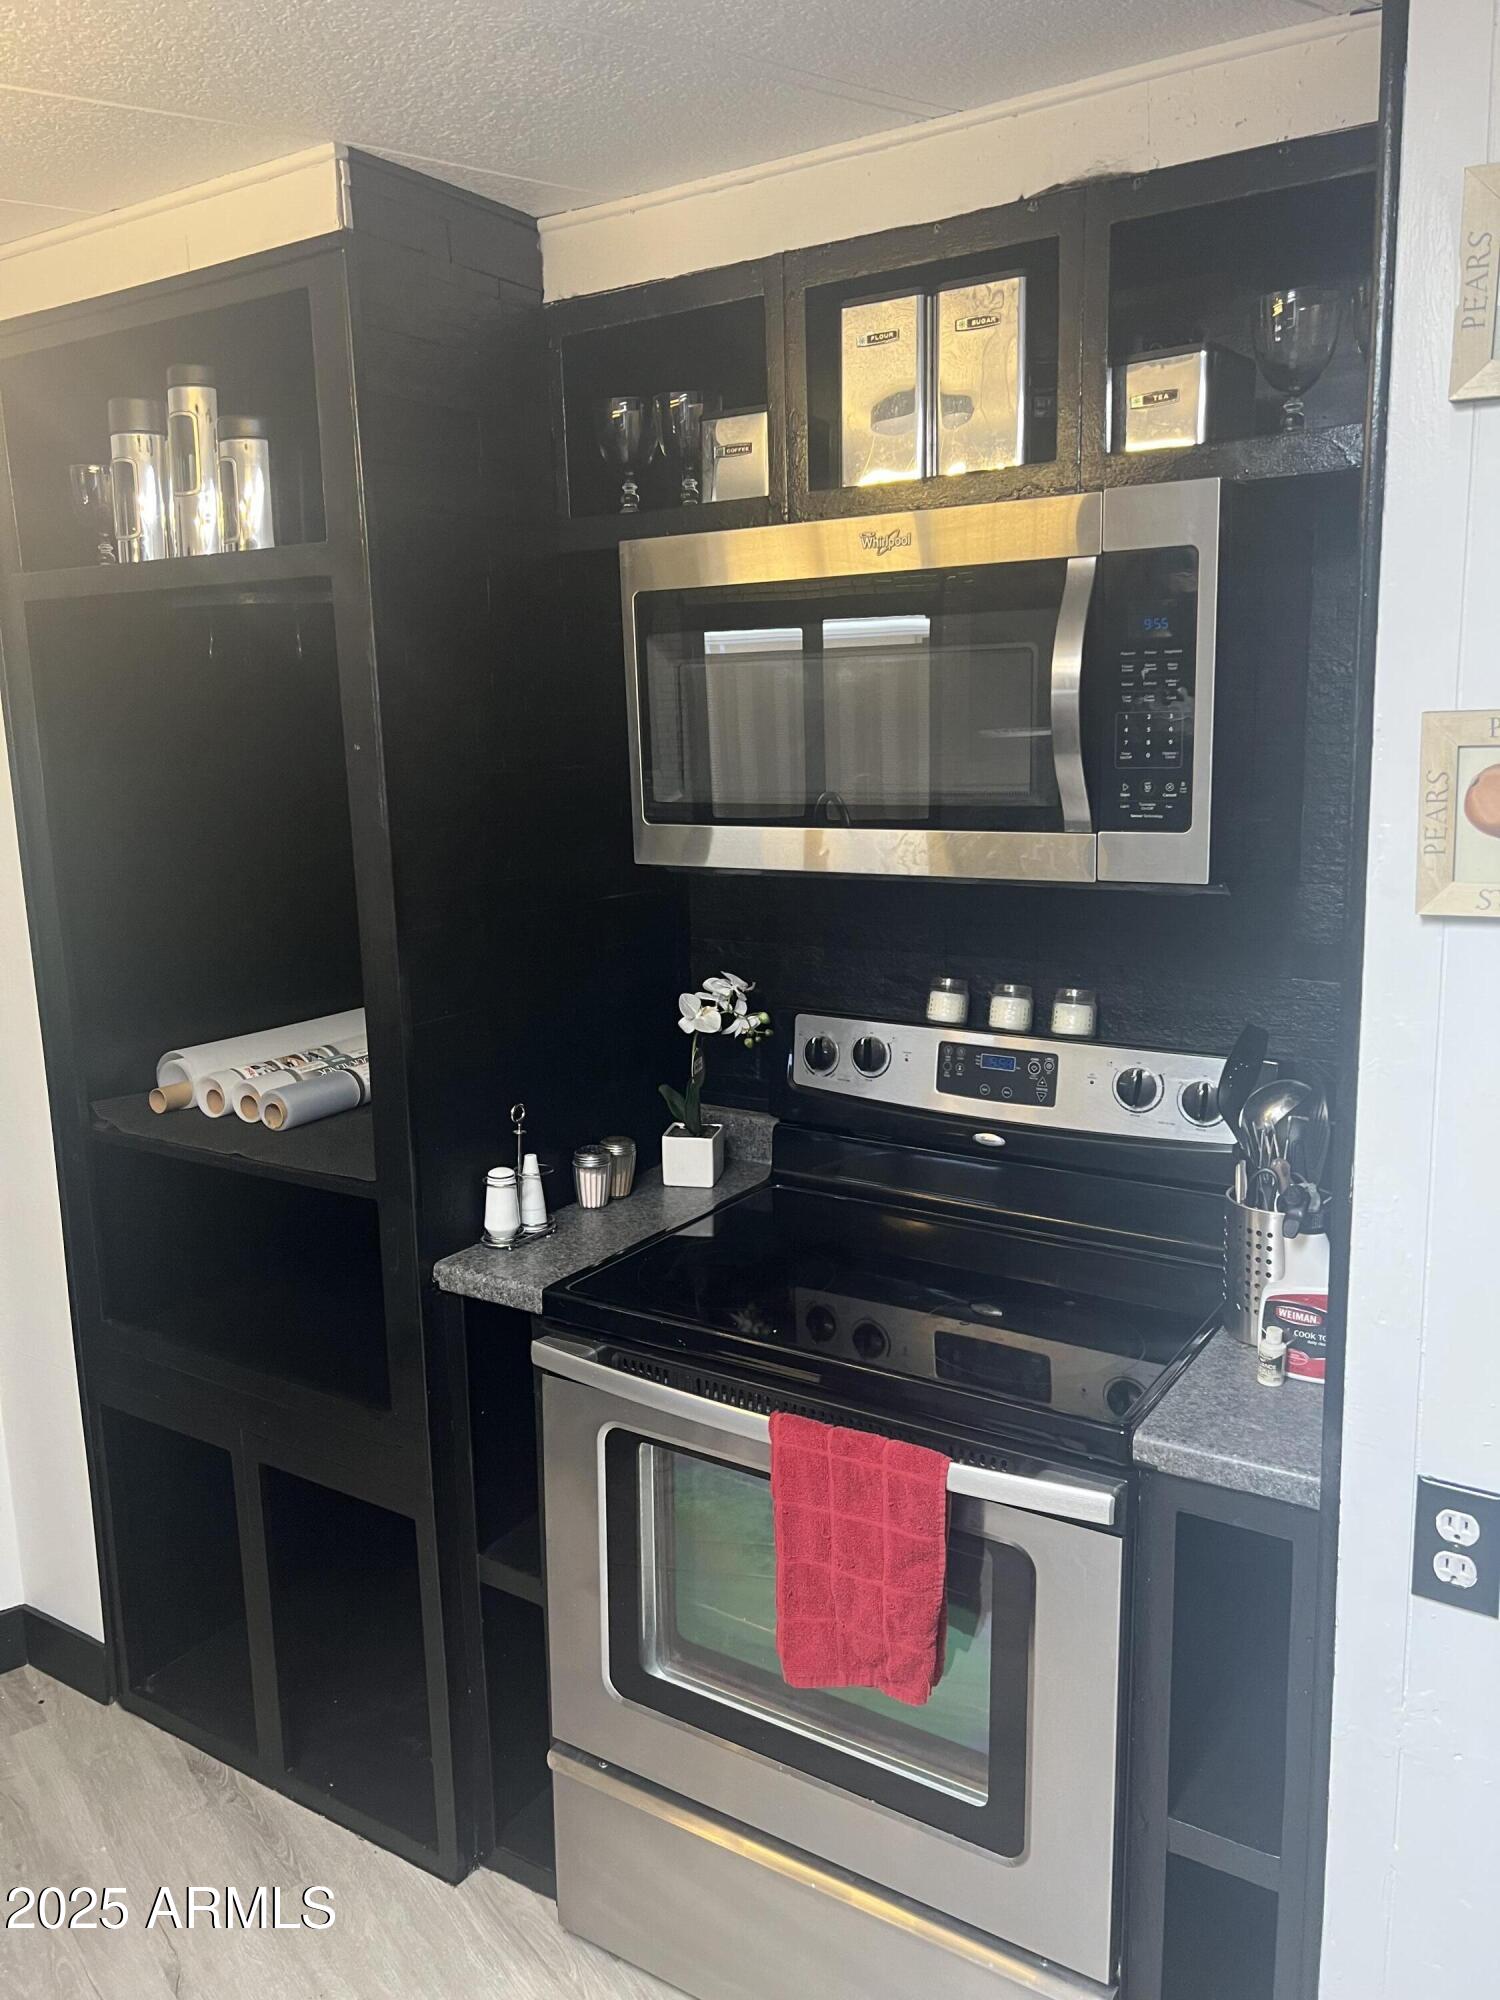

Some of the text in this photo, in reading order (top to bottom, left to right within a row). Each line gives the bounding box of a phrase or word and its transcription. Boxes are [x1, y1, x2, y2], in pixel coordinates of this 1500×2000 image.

[1461, 231, 1492, 330] PEARS
[970, 315, 997, 326] SUGAR
[870, 331, 895, 342] FLOUR
[1153, 393, 1169, 401] TEA
[860, 529, 912, 556] Whirlpool
[1424, 770, 1449, 855] PEARS
[1278, 1307, 1317, 1324] WEIMAN
[1293, 1329, 1317, 1341] COOK
